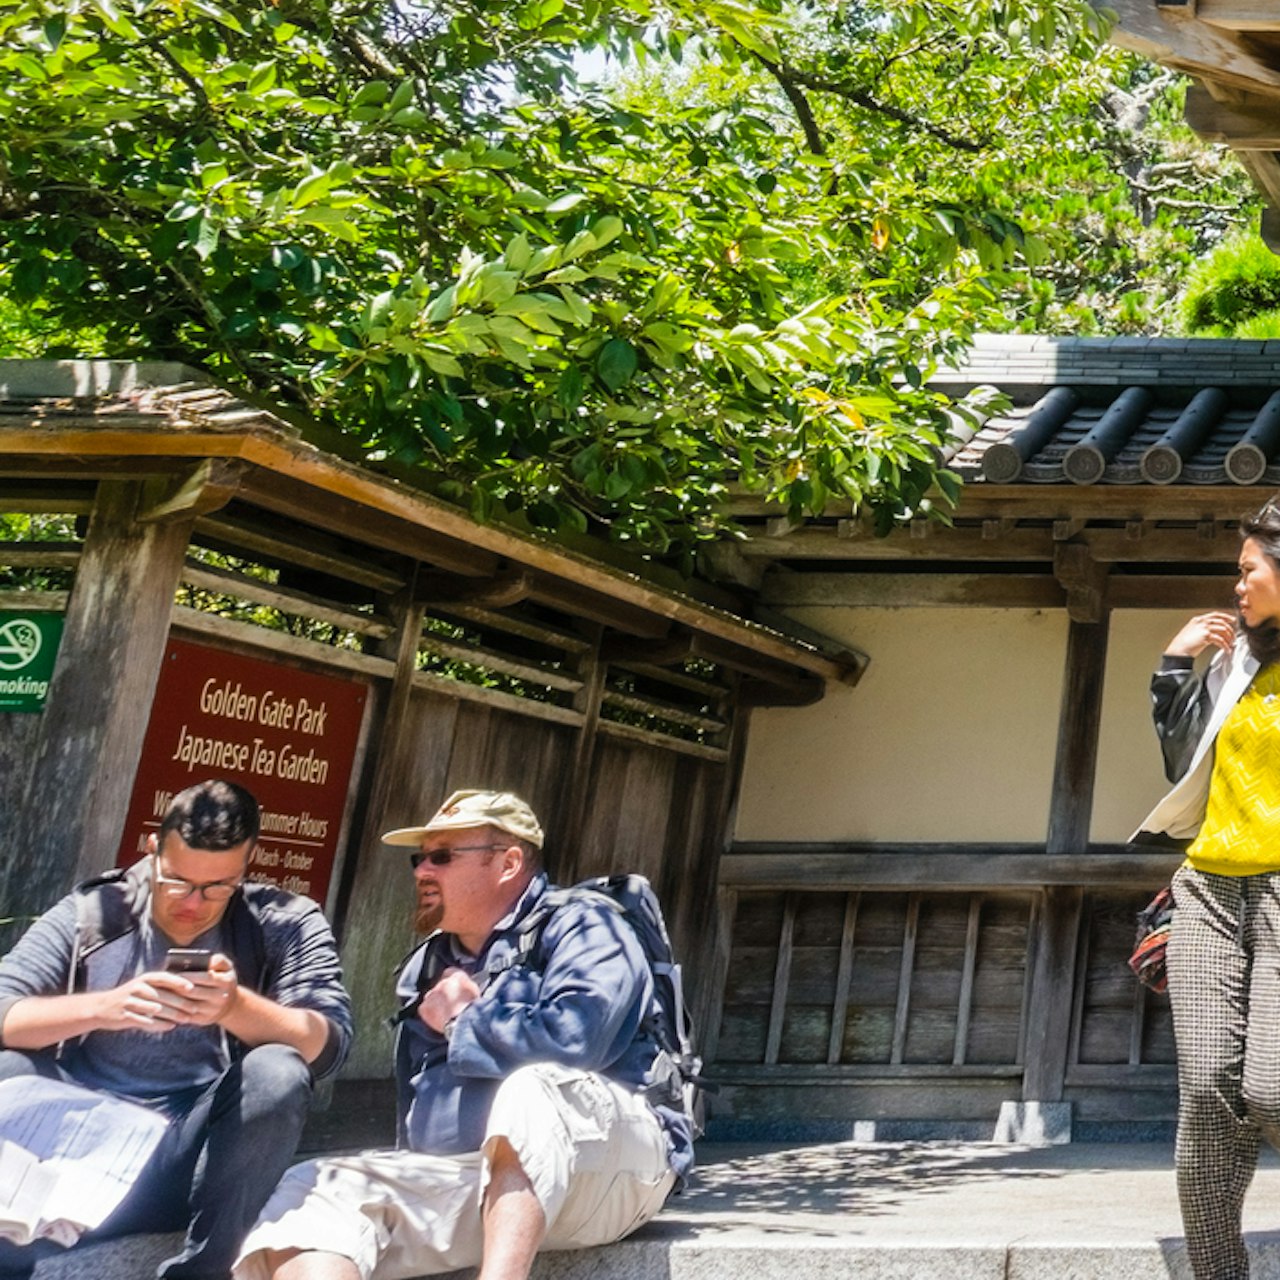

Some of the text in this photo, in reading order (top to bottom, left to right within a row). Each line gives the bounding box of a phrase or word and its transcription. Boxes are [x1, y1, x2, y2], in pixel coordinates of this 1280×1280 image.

[200, 677, 328, 736] Golden Gate Park
[172, 725, 329, 786] Japanese Tea Garden
[258, 804, 329, 839] ummer Hours
[255, 846, 280, 867] March
[284, 850, 315, 870] October
